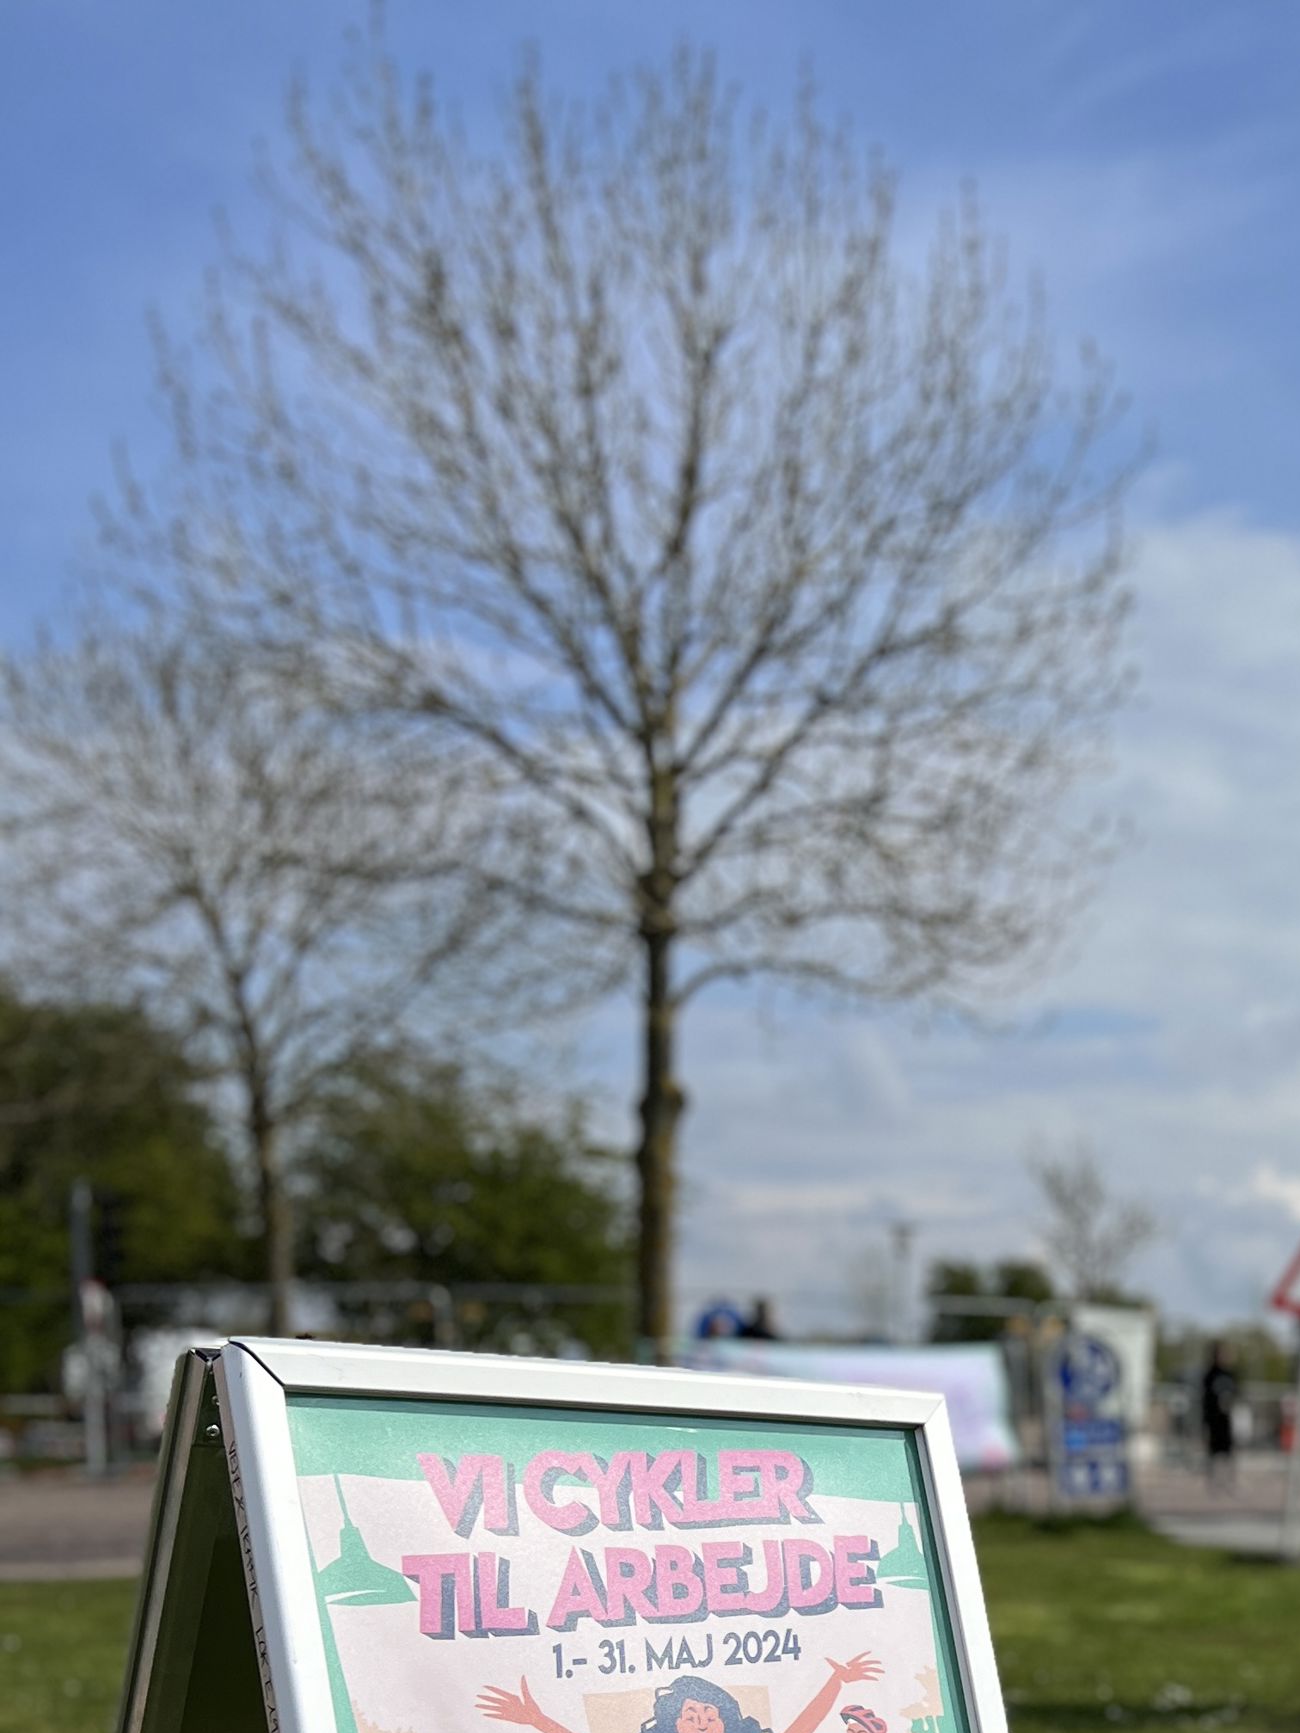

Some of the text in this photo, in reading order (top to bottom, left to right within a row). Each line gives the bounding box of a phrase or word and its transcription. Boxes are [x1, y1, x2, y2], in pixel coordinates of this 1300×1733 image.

[416, 1449, 826, 1540] VI CYKLER
[401, 1535, 885, 1641] TIL ARBEJDE
[646, 1633, 714, 1671] MAJ
[722, 1628, 802, 1667] 2024
